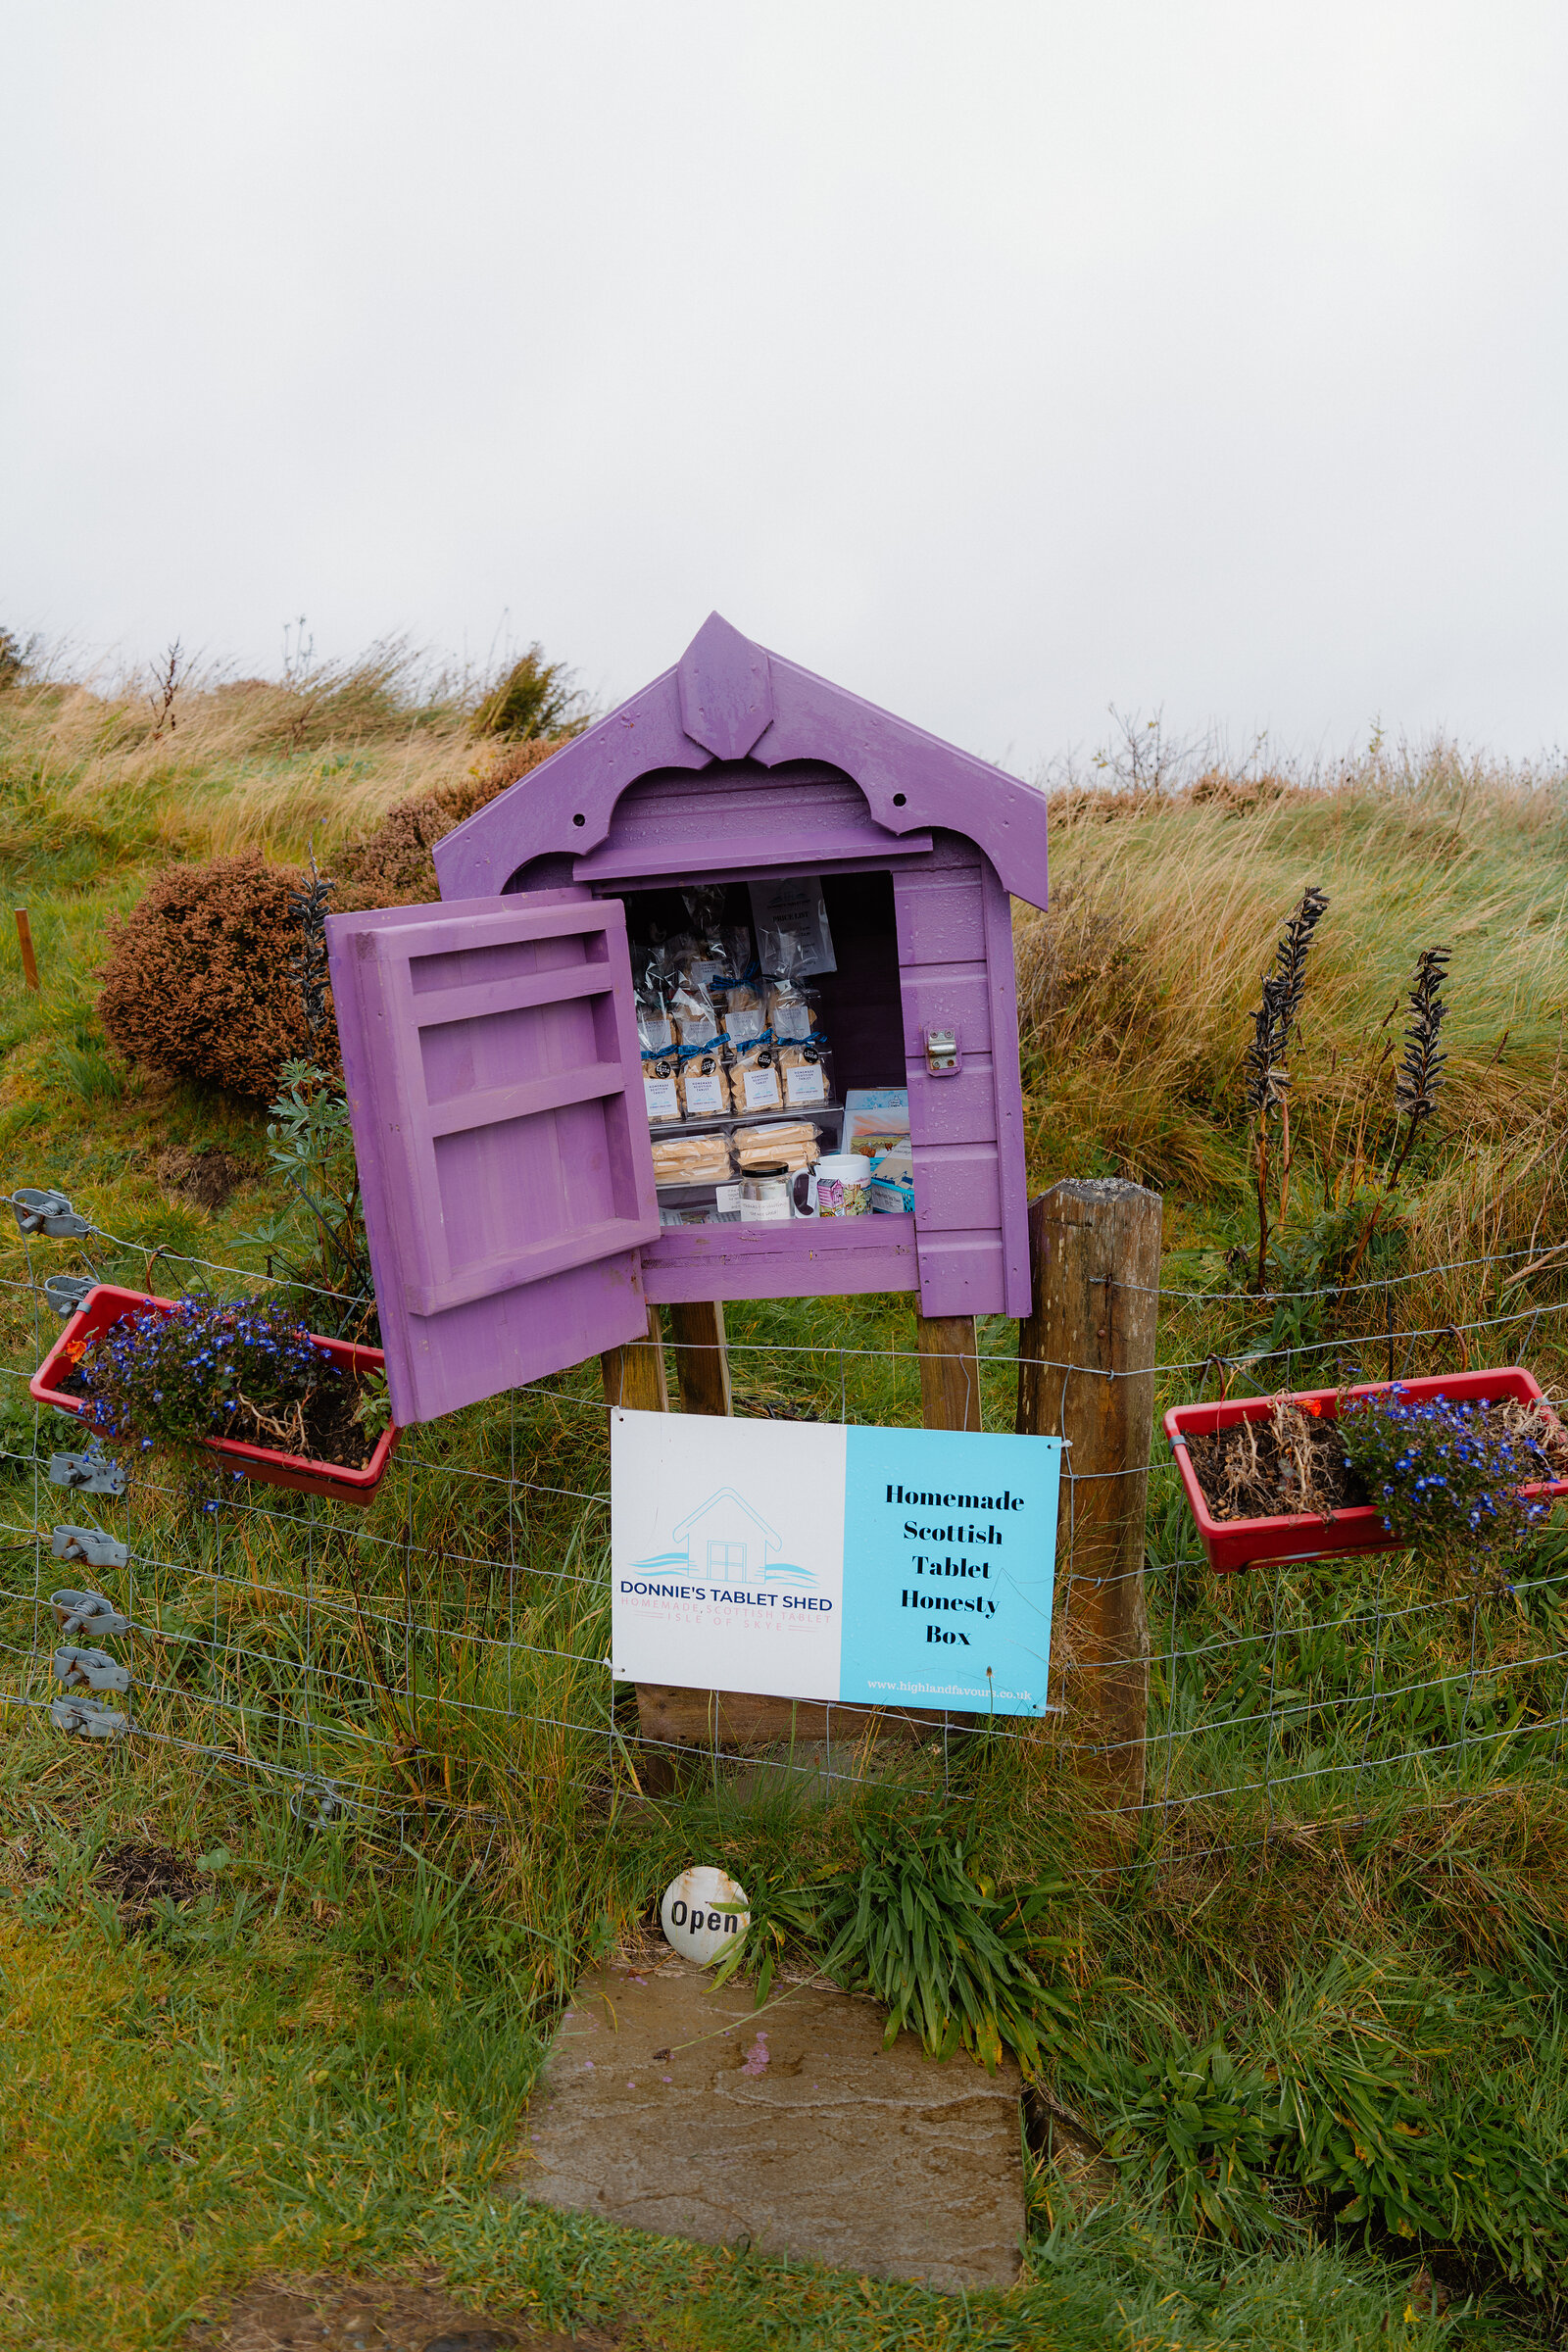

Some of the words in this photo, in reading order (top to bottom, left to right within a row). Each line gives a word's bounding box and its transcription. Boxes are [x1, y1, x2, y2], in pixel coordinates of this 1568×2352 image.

[772, 912, 793, 921] PRICE
[885, 1484, 1025, 1511] Homemade
[903, 1520, 1003, 1545] Scottish
[911, 1555, 992, 1579] Tablet
[620, 1581, 706, 1600] DONNIE'S
[710, 1589, 778, 1607] TABLET
[782, 1595, 833, 1611] SHED
[901, 1589, 1001, 1619] Honesty
[621, 1596, 699, 1612] HOMEMADE
[706, 1604, 773, 1620] SCOTTISH
[781, 1611, 832, 1624] TABLET
[667, 1613, 702, 1624] ISLE
[712, 1617, 732, 1627] OF
[744, 1620, 782, 1632] SKYE
[925, 1624, 972, 1645] Box
[867, 1679, 1032, 1700] www.highlandfavours.co.uk
[670, 1900, 738, 1935] Open
